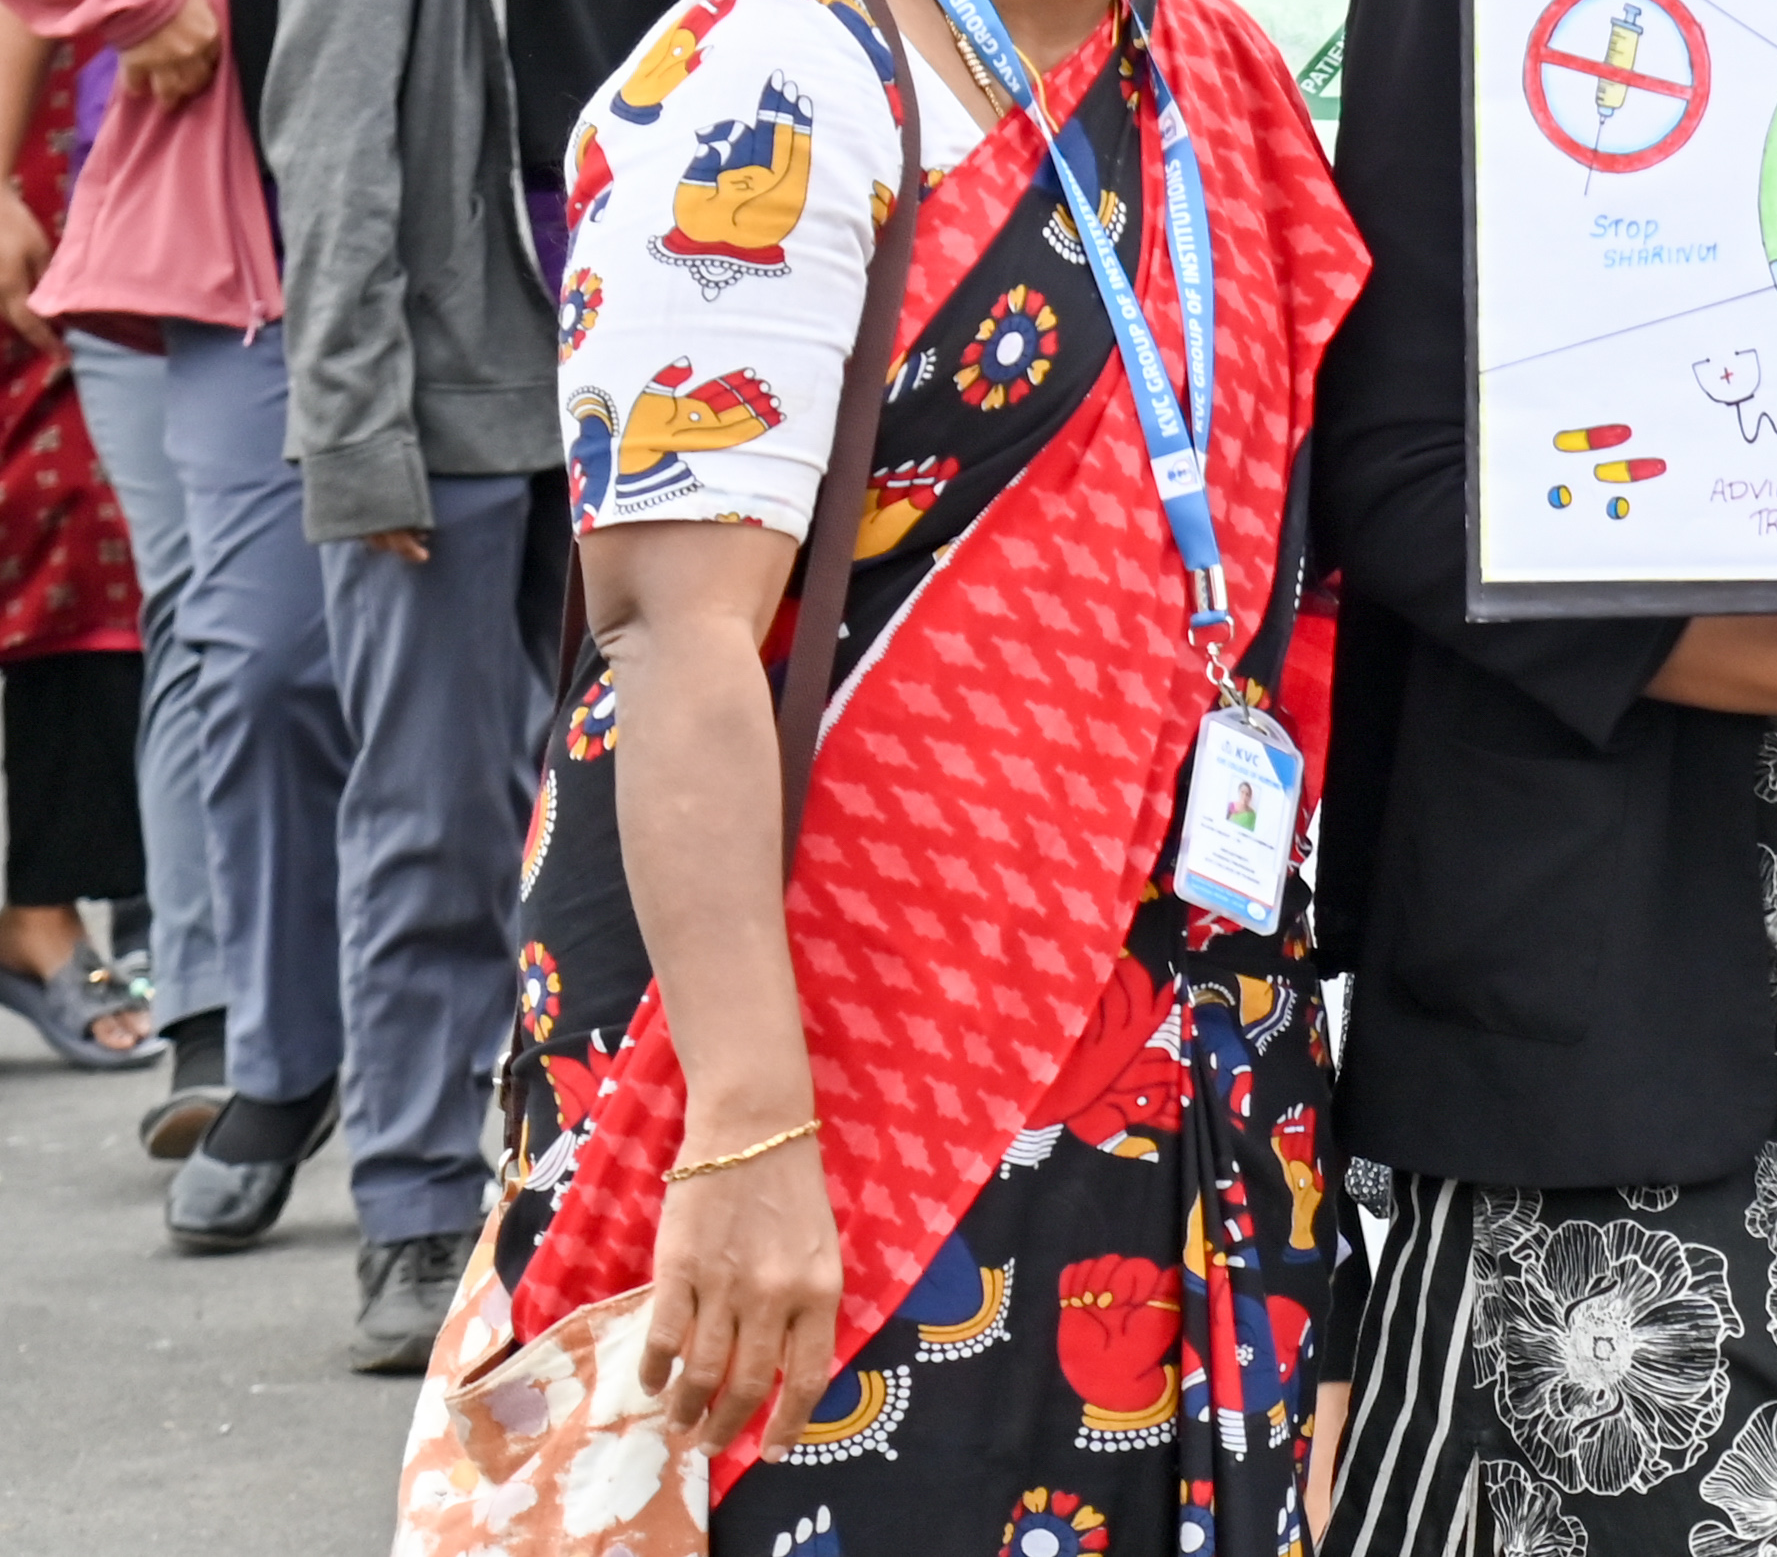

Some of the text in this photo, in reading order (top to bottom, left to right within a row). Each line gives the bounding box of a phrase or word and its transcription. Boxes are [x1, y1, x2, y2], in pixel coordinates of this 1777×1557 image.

[992, 53, 1022, 93] KVC
[1300, 34, 1344, 94] PATIE
[1165, 158, 1200, 284] INSTITUTIONS
[1590, 213, 1659, 245] STOP
[1186, 289, 1203, 315] OF
[1116, 292, 1180, 438] KVC GROUP OF
[1191, 318, 1206, 388] GROUP
